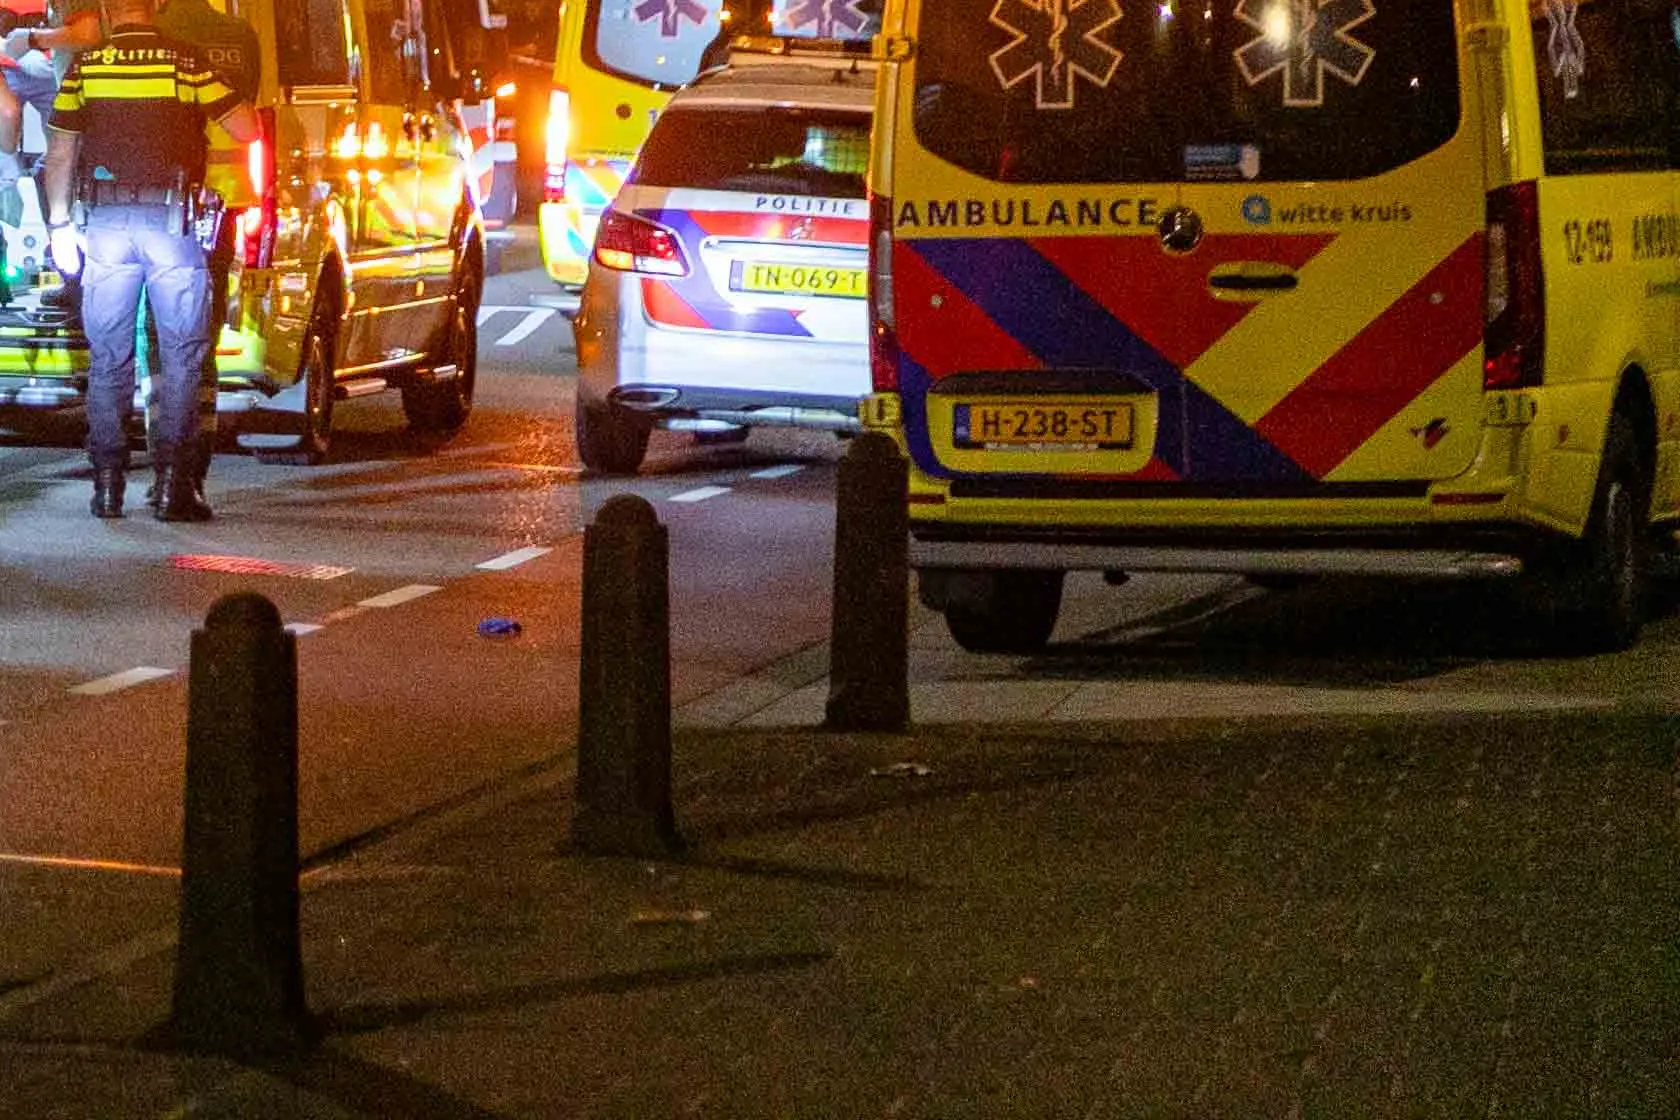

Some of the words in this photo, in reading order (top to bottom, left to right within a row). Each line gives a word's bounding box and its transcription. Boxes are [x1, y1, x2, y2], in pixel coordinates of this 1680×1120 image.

[756, 196, 854, 215] POLITIE
[897, 199, 1160, 227] AMBULANCE
[1279, 203, 1344, 223] witte
[1351, 201, 1413, 223] kruis
[752, 265, 863, 290] TN-069-T
[982, 410, 1117, 438] H-238-ST
